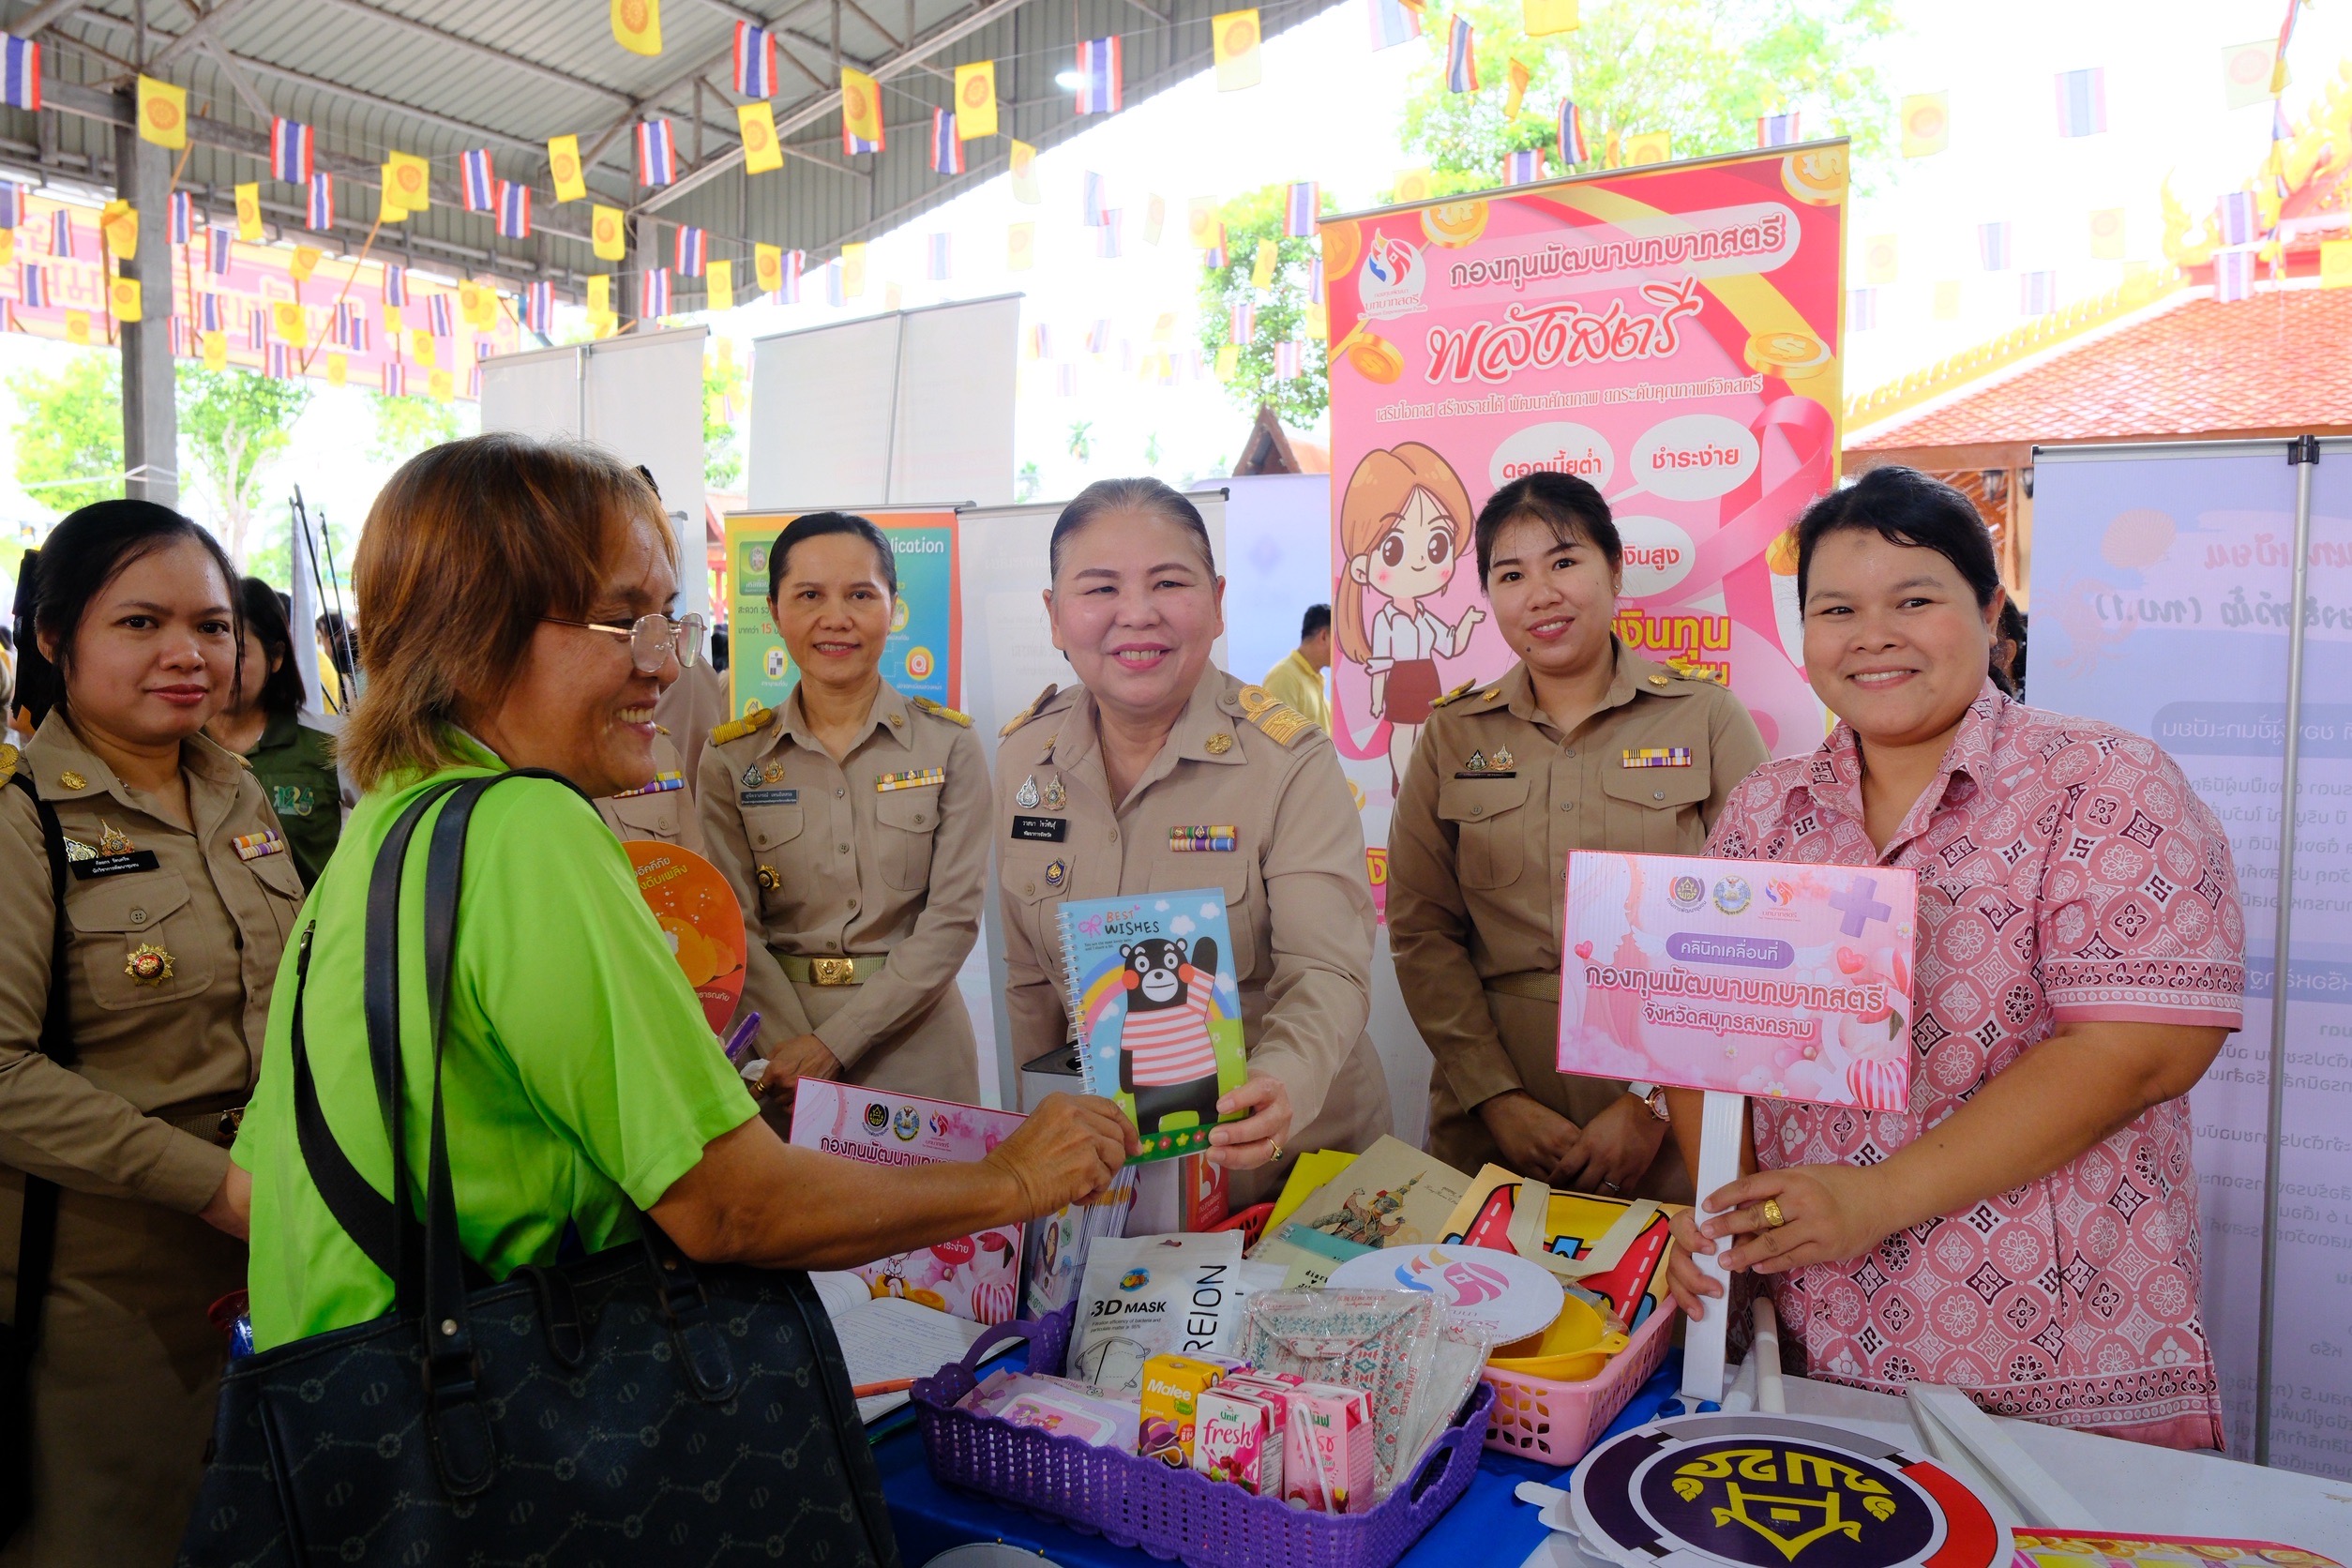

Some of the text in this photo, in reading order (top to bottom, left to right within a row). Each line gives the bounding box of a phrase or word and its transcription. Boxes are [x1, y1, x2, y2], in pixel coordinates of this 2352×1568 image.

[1450, 215, 1784, 288] กองทุนพัฒนาบทบาทสตรี
[1365, 294, 1420, 310] บทบาทสตรี
[1430, 276, 1700, 380] พลังสตรี
[1377, 375, 1762, 421] เสริมโอกาส สร้างรายได้ พัฒนาศักยภาพ ยกระดับคุณภาพชีวิตสตรี
[1651, 447, 1741, 472] ชำระง่าย
[761, 623, 772, 634] 15
[1105, 921, 1159, 936] WISHES
[1107, 910, 1134, 923] BEST
[1681, 938, 1778, 962] คลินิกเคลื่อนที่
[1584, 963, 1884, 1013] กองทุนพัฒนาบทบาทสตรี
[1643, 1001, 1813, 1038] จังหวัดสมุทรสงคราม
[1091, 1300, 1167, 1318] 3D MASK
[1147, 1379, 1192, 1401] Malee
[1220, 1410, 1239, 1423] Unif
[1203, 1418, 1253, 1447] fresh
